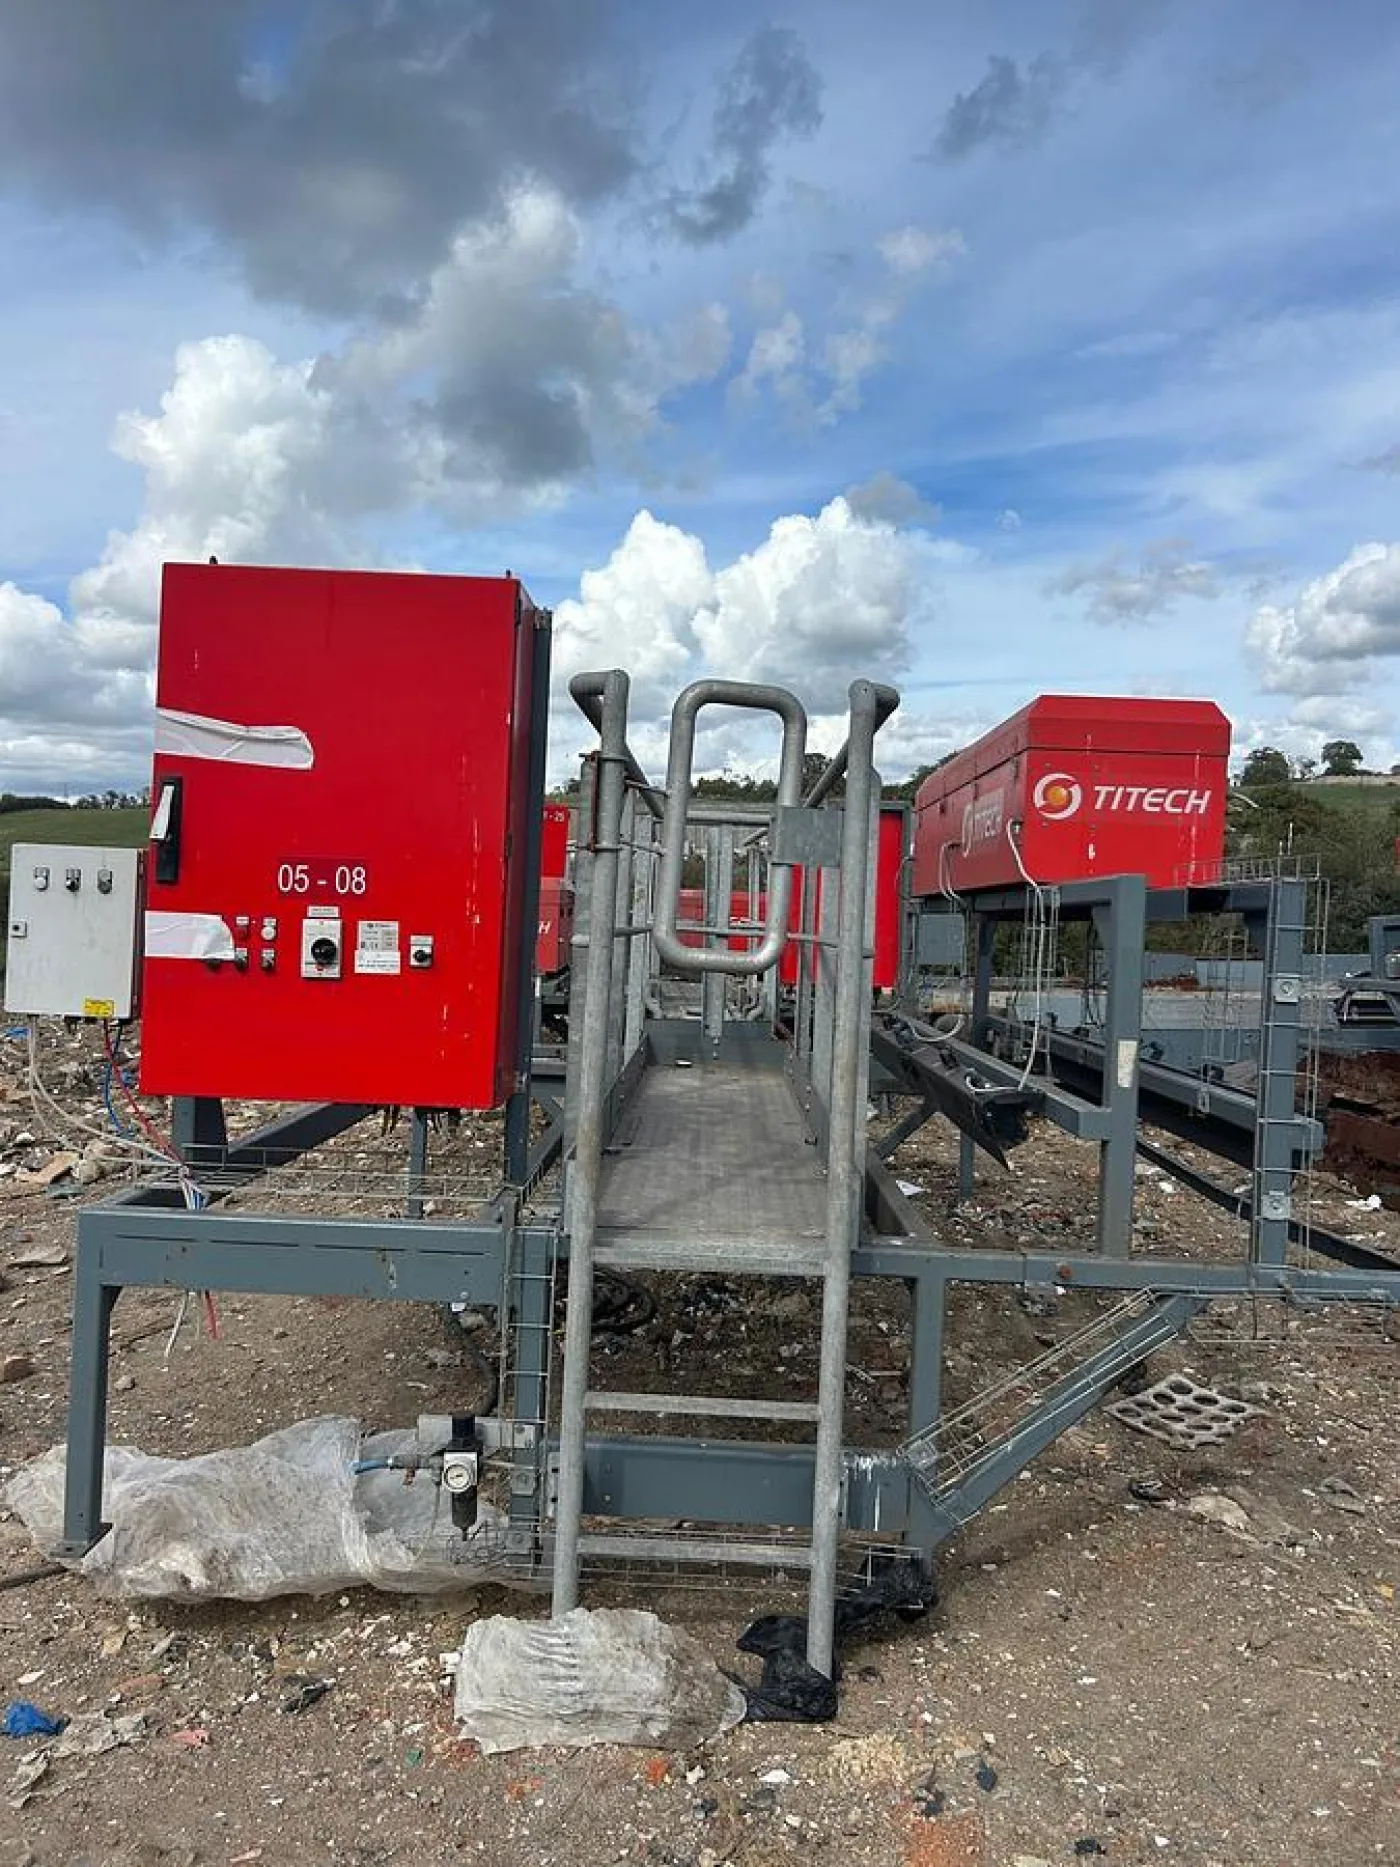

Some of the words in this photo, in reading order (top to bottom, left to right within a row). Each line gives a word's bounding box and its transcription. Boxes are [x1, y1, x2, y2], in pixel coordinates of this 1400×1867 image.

[1094, 785, 1212, 814] TITECH
[278, 864, 309, 893] 05
[336, 866, 365, 894] 08
